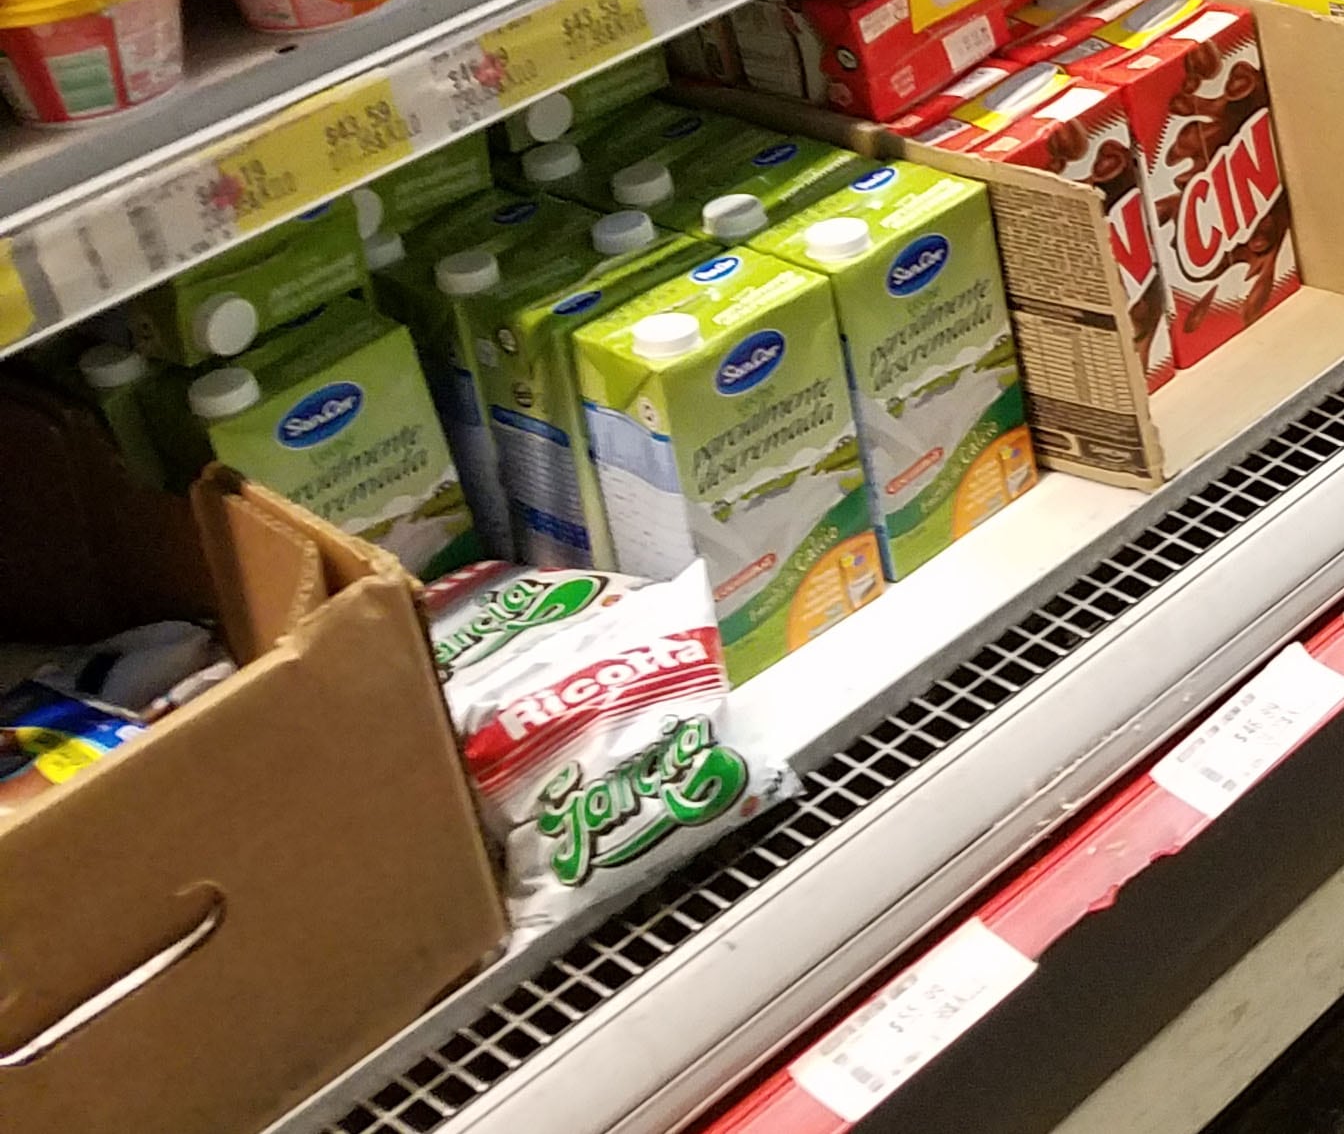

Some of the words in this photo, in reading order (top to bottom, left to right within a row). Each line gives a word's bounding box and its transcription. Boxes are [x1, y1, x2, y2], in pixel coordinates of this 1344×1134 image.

[890, 248, 946, 286] SanCor
[721, 341, 782, 385] SanCor
[499, 633, 709, 741] Ricotta
